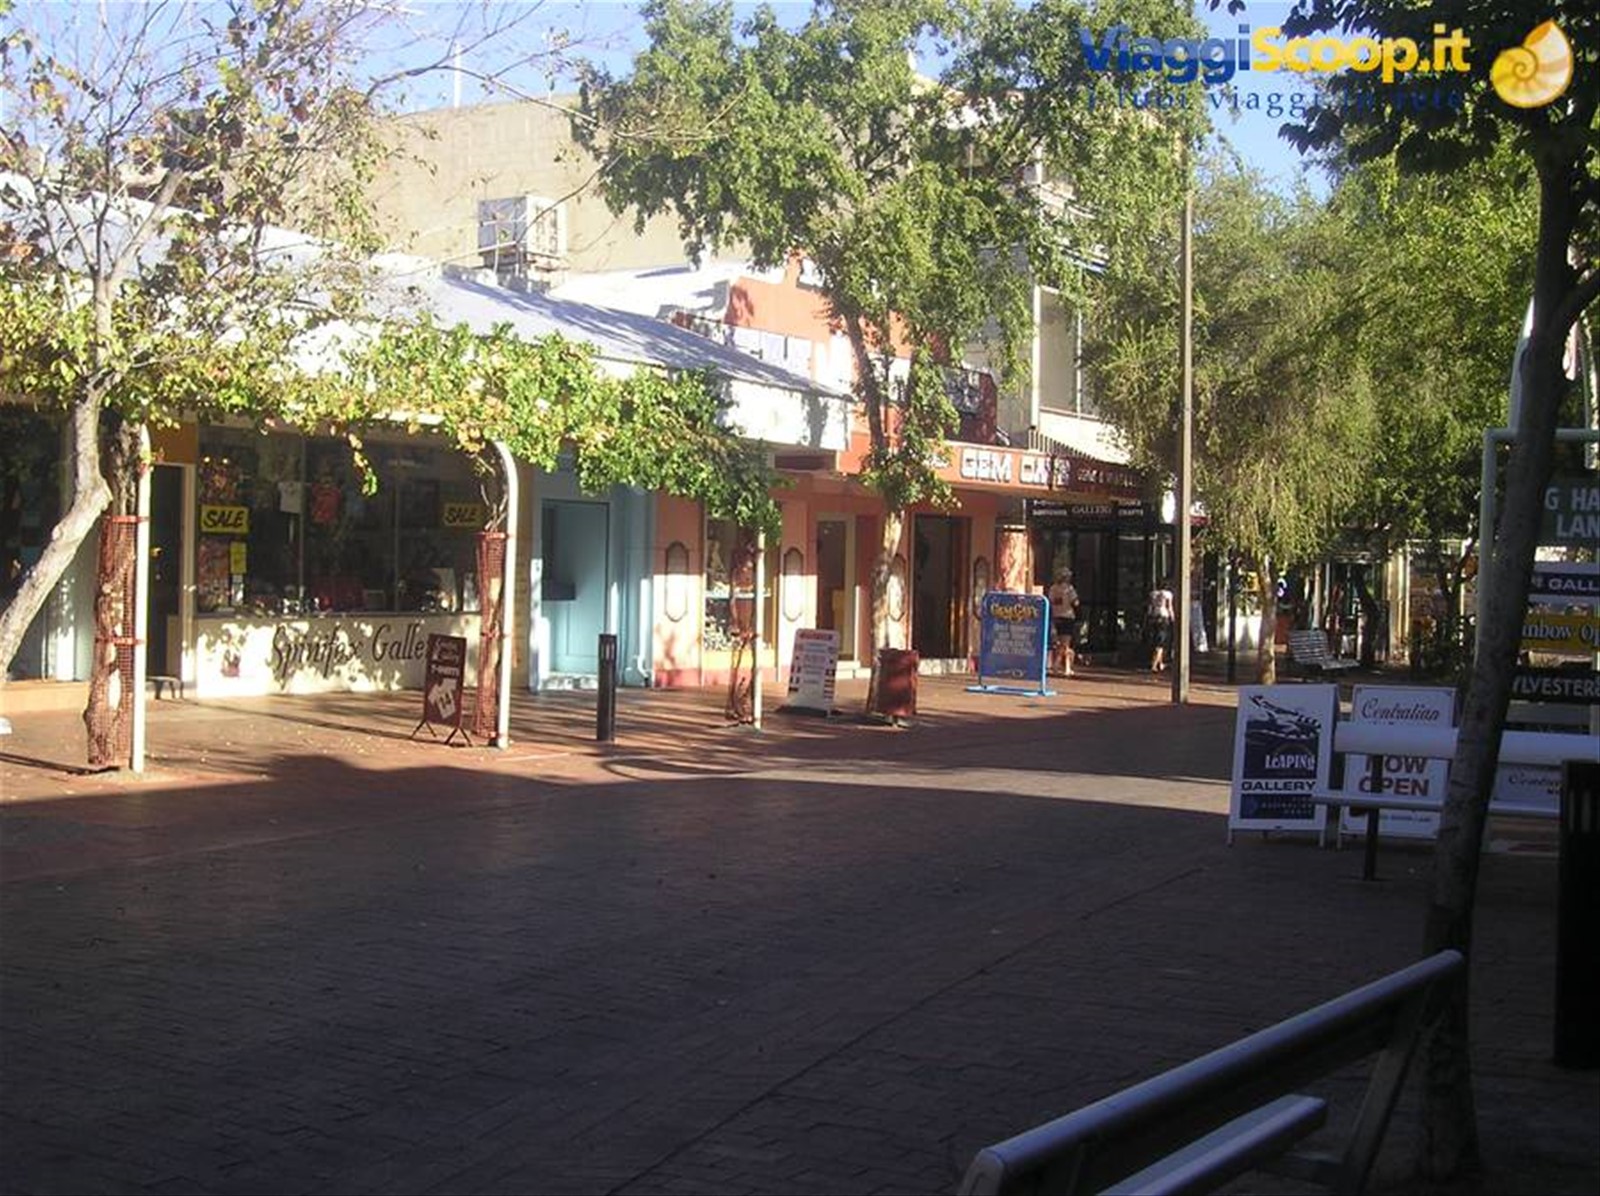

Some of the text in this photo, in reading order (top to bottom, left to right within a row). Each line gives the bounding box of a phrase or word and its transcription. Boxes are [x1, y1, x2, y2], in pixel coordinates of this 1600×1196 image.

[960, 447, 1013, 482] GEM
[203, 508, 244, 529] SALE
[445, 506, 478, 524] SALE
[1548, 577, 1600, 592] GALL
[268, 622, 364, 687] Spinifex
[1241, 781, 1317, 792] GALLERY
